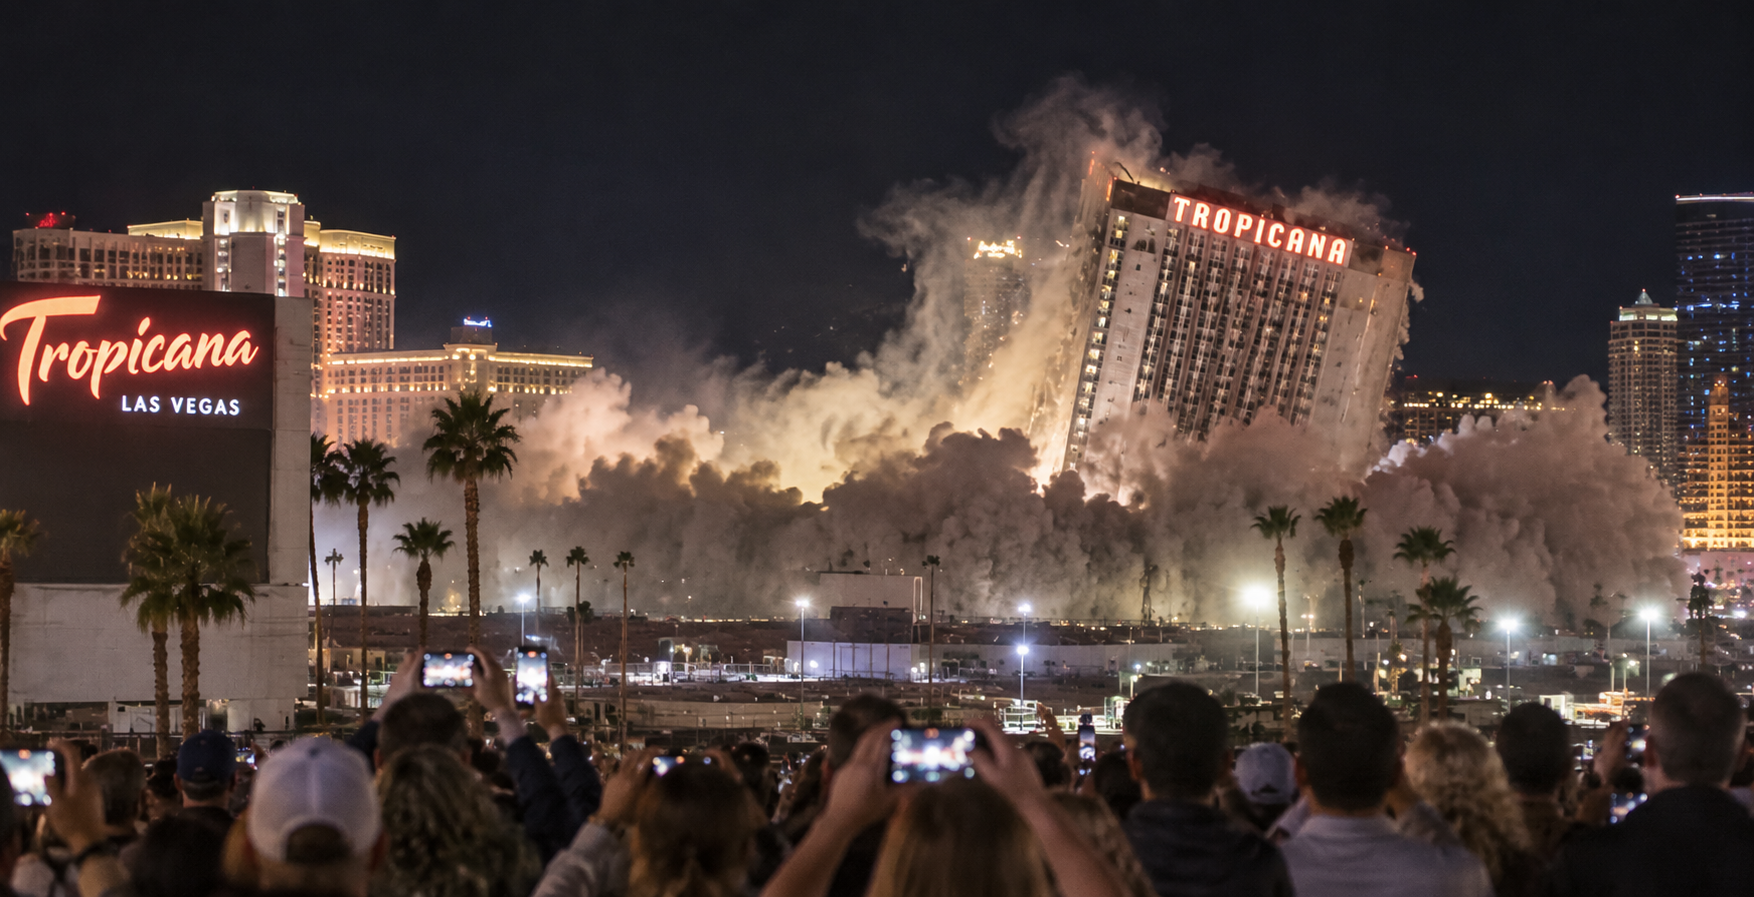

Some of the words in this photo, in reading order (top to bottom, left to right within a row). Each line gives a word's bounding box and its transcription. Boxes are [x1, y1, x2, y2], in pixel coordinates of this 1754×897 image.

[1174, 196, 1346, 265] TROPICANA
[0, 295, 259, 406] Tropicana
[121, 395, 160, 413] LAS
[171, 397, 240, 416] VEGAS
